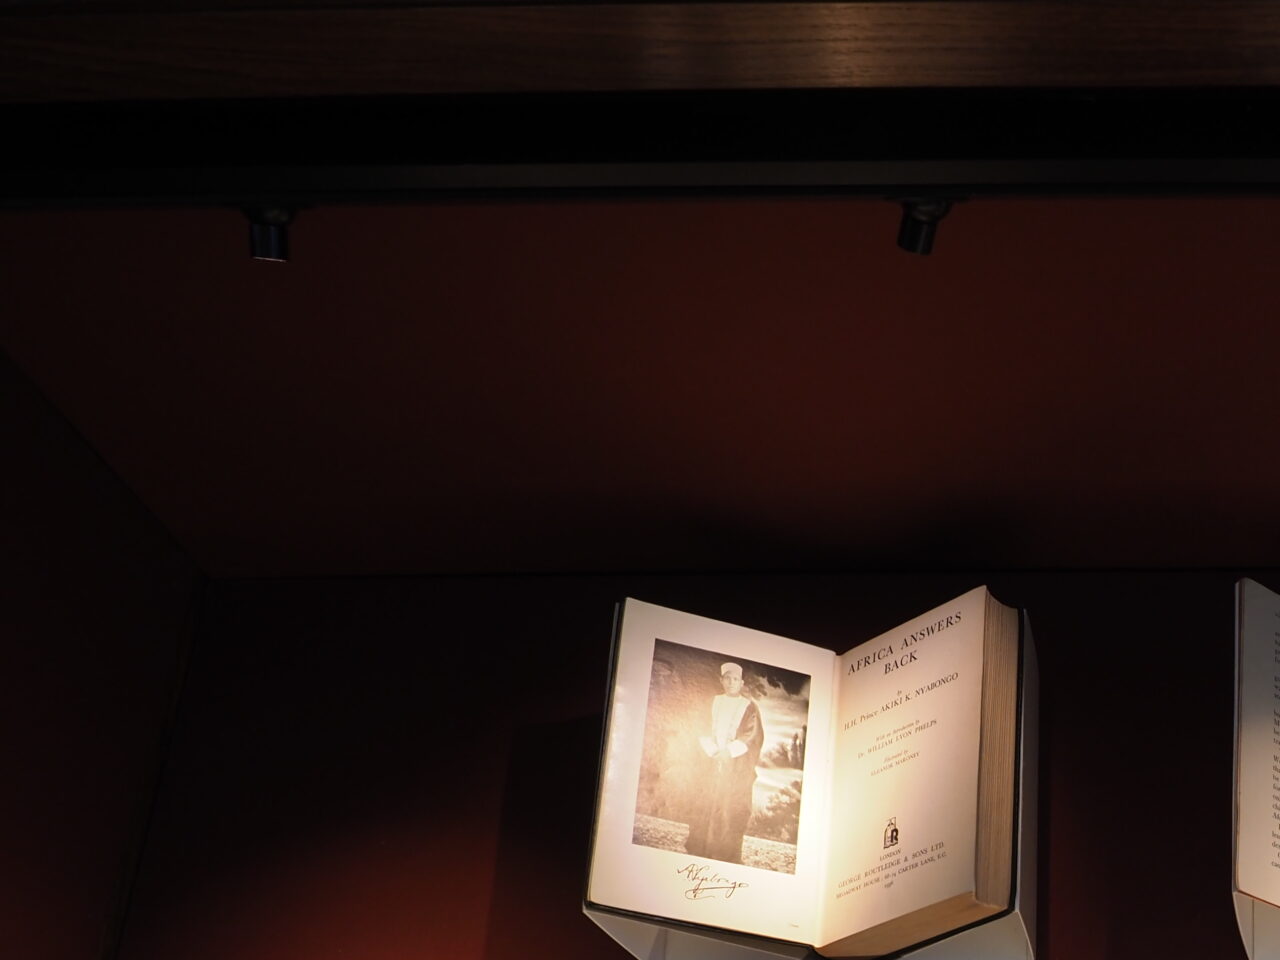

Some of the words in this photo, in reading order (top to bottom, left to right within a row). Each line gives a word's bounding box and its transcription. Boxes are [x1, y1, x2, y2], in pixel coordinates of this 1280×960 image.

[847, 645, 894, 676] AFRICA
[900, 611, 962, 650] ANSWERS
[883, 650, 918, 675] BACK
[879, 697, 903, 713] AKIKI
[914, 672, 959, 698] NYABONGO
[879, 848, 902, 861] LONDON
